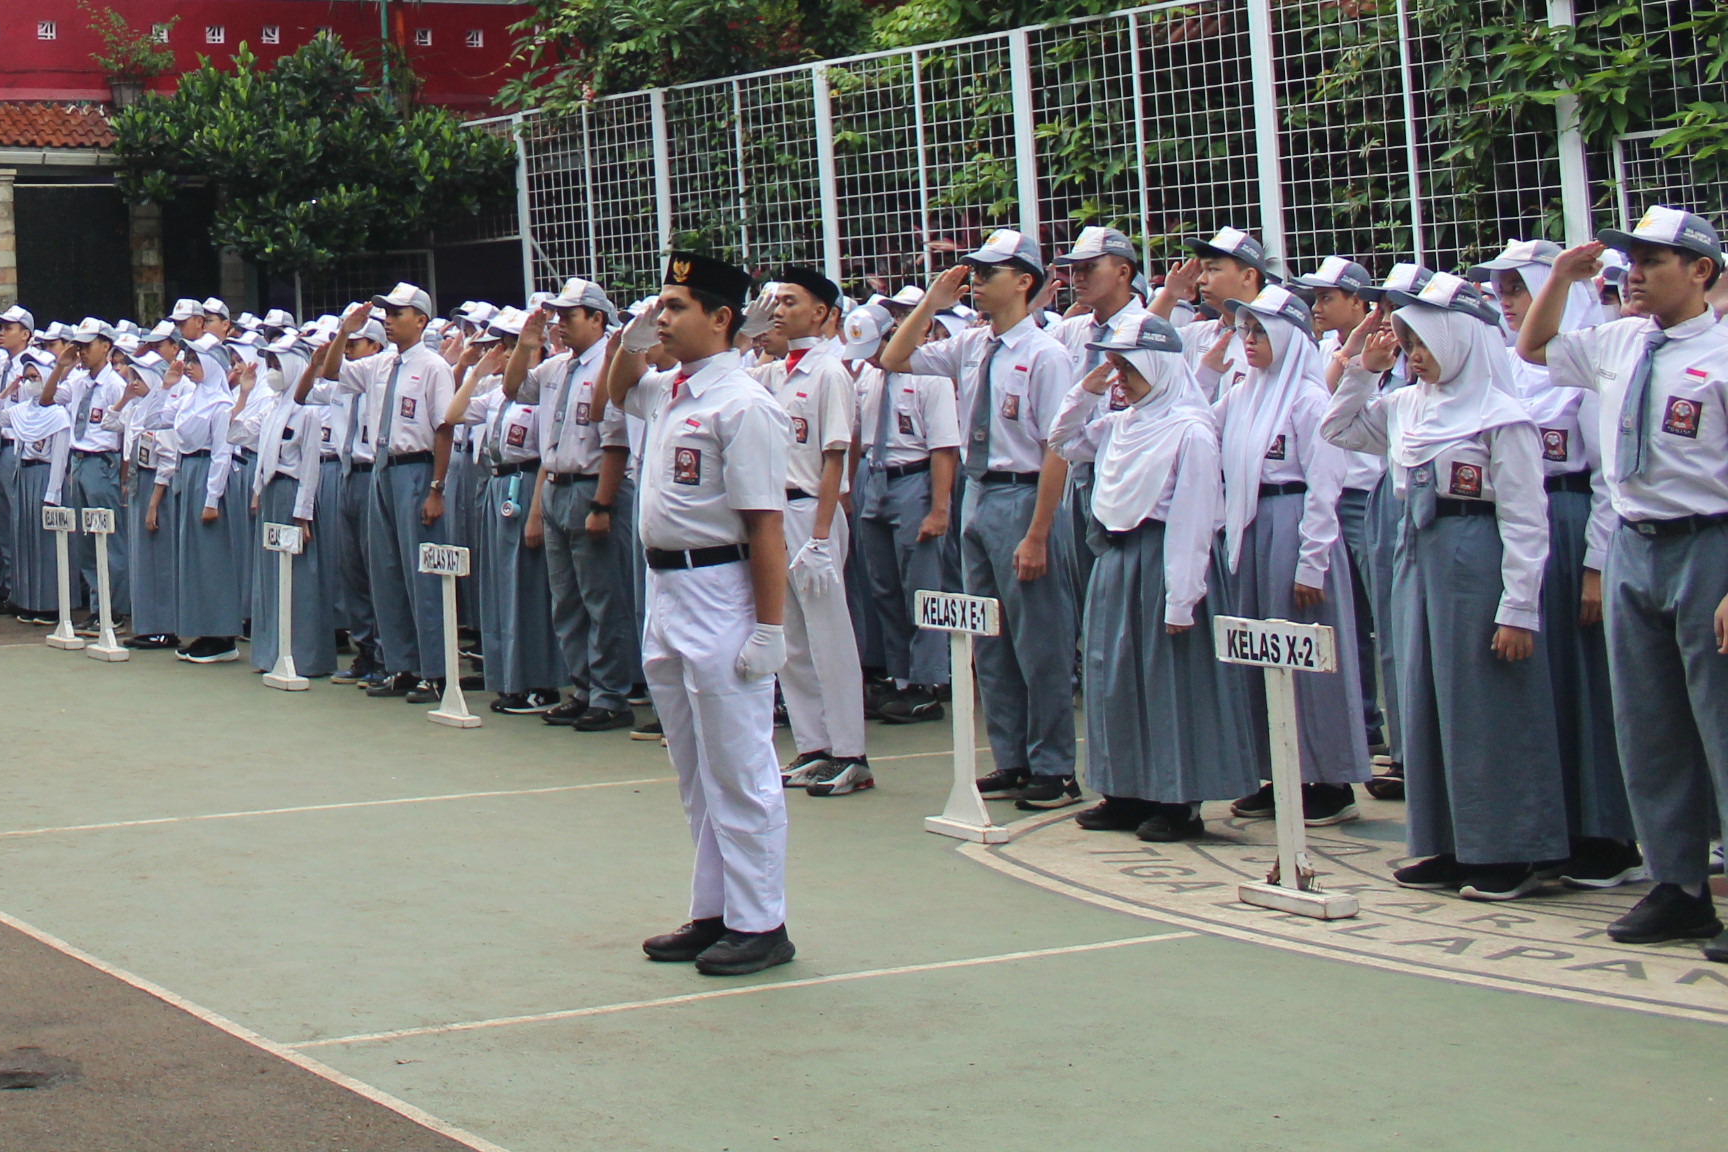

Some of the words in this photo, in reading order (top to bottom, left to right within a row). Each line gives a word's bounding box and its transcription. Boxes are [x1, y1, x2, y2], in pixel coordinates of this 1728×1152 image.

[923, 596, 957, 628] KELAS
[959, 599, 967, 628] X
[971, 601, 986, 631] E-1
[1227, 629, 1280, 664] KELAS
[1286, 635, 1314, 667] X-2
[1089, 847, 1228, 894] TIGA
